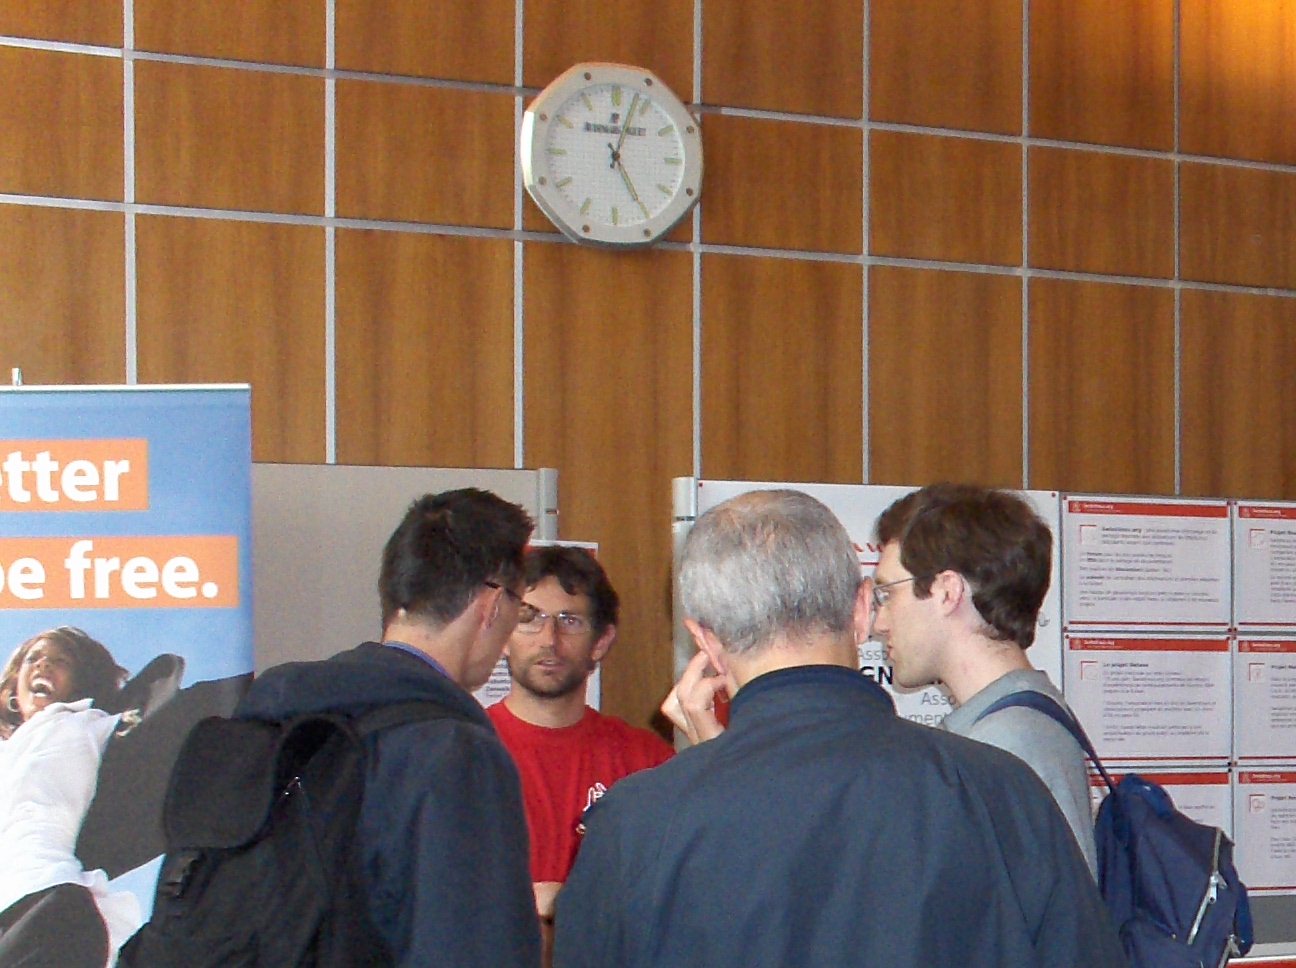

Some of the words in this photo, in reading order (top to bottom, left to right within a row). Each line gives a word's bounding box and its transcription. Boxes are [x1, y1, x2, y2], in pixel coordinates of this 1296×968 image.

[0, 451, 130, 503] tter
[0, 557, 46, 600] e
[65, 540, 219, 599] free.
[859, 648, 888, 661] Asso
[861, 666, 893, 684] GN
[921, 692, 956, 706] Asso
